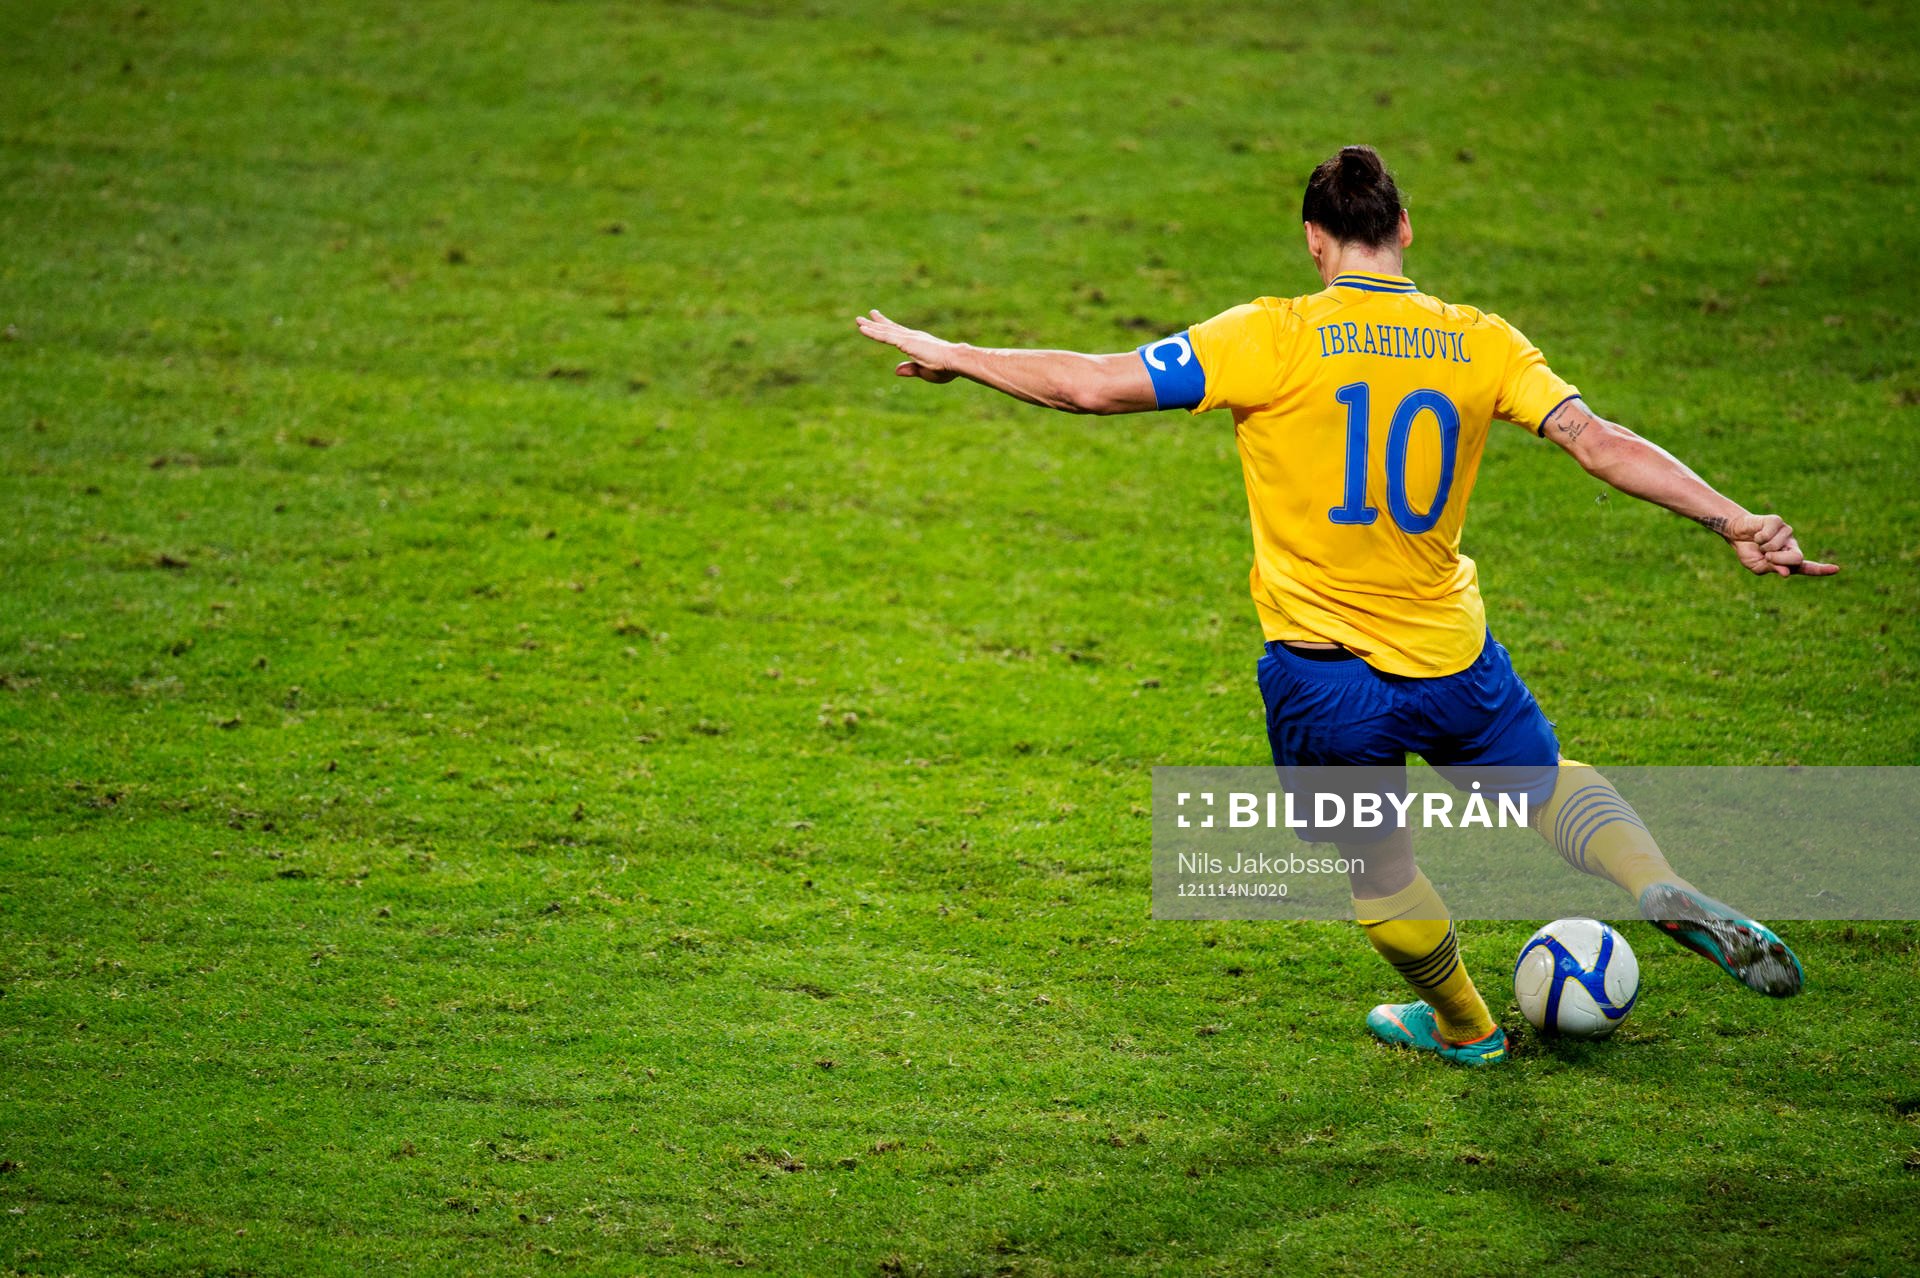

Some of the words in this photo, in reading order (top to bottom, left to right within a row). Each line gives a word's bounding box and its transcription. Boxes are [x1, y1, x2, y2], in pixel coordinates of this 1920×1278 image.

[1145, 336, 1192, 371] C
[1317, 322, 1471, 363] IBRAHIMOVIC
[1328, 381, 1460, 534] 10
